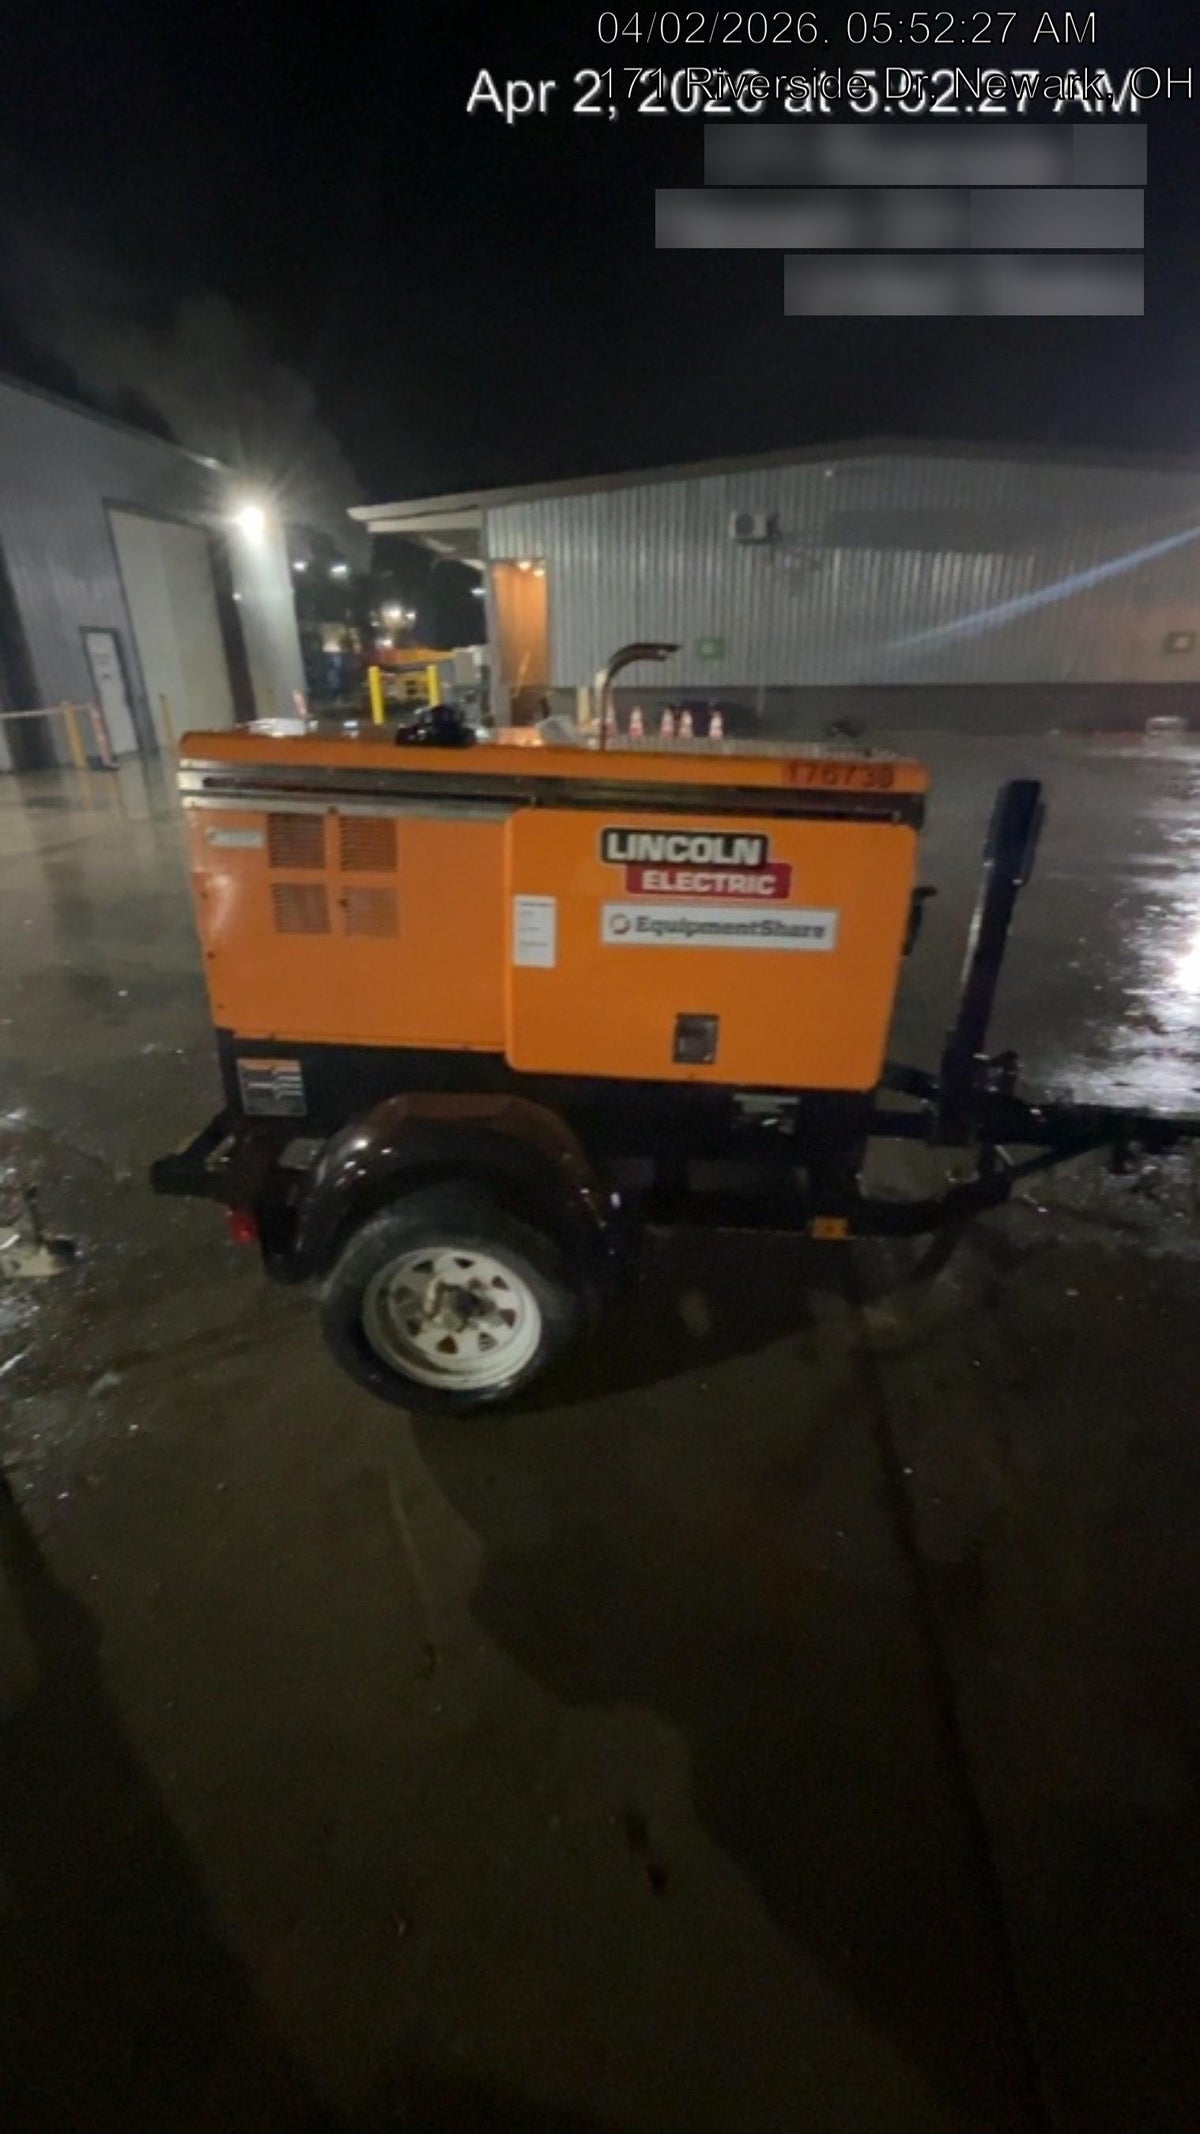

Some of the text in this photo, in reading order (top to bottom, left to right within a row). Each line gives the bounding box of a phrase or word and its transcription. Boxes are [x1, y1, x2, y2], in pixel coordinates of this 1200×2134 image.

[605, 831, 765, 867] LINCOLN
[641, 869, 778, 896] ELECTRIC
[635, 915, 828, 939] EquipmentShare
